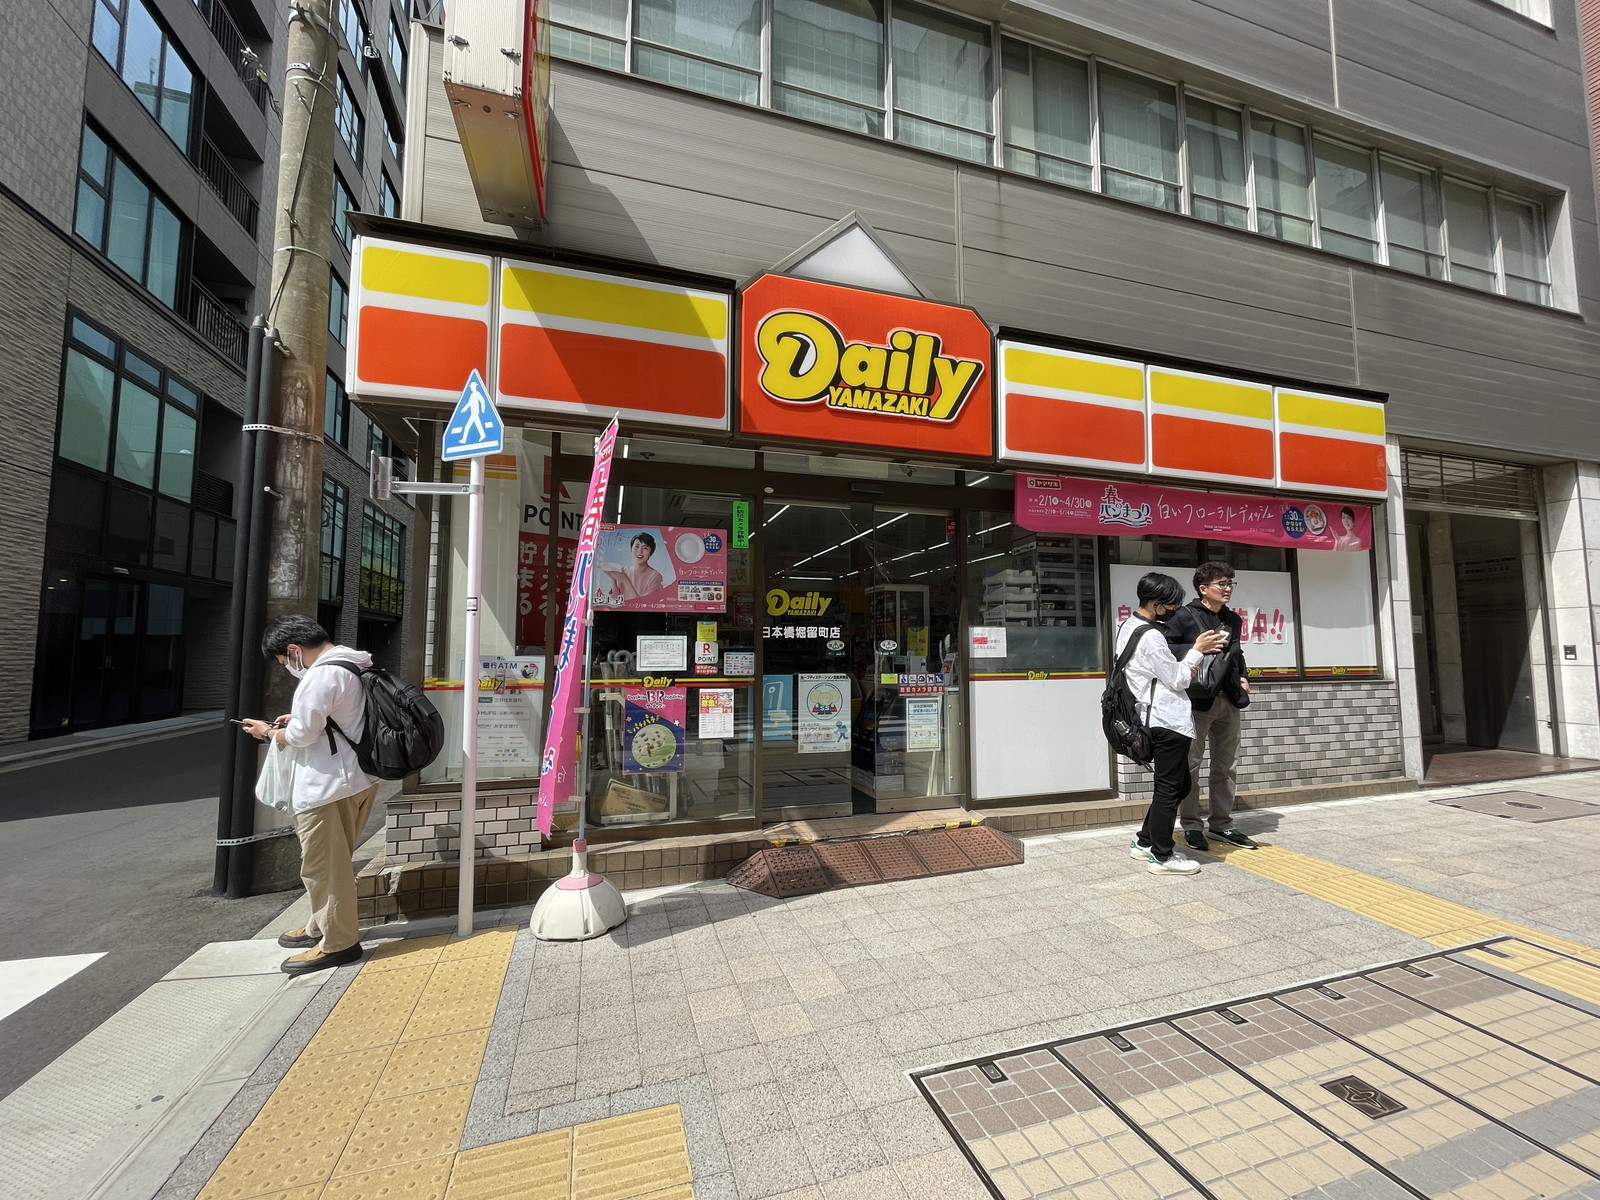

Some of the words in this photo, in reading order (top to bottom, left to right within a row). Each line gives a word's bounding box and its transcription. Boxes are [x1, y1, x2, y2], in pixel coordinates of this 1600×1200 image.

[757, 310, 984, 420] Daily
[828, 385, 930, 417] YAMAZAKI
[1157, 493, 1274, 524] 白いフローラルディッシュ
[523, 504, 584, 532] PONT
[1289, 510, 1299, 521] 30
[519, 541, 538, 616] 貯まる
[766, 588, 833, 616] Daily
[762, 626, 841, 639] 日本橋堀留町店
[702, 643, 711, 655] R
[482, 661, 518, 670] 銀行ATM
[1331, 666, 1347, 675] Daily
[643, 675, 673, 688] Daily
[1027, 670, 1049, 680] Daily
[478, 677, 502, 690] aily
